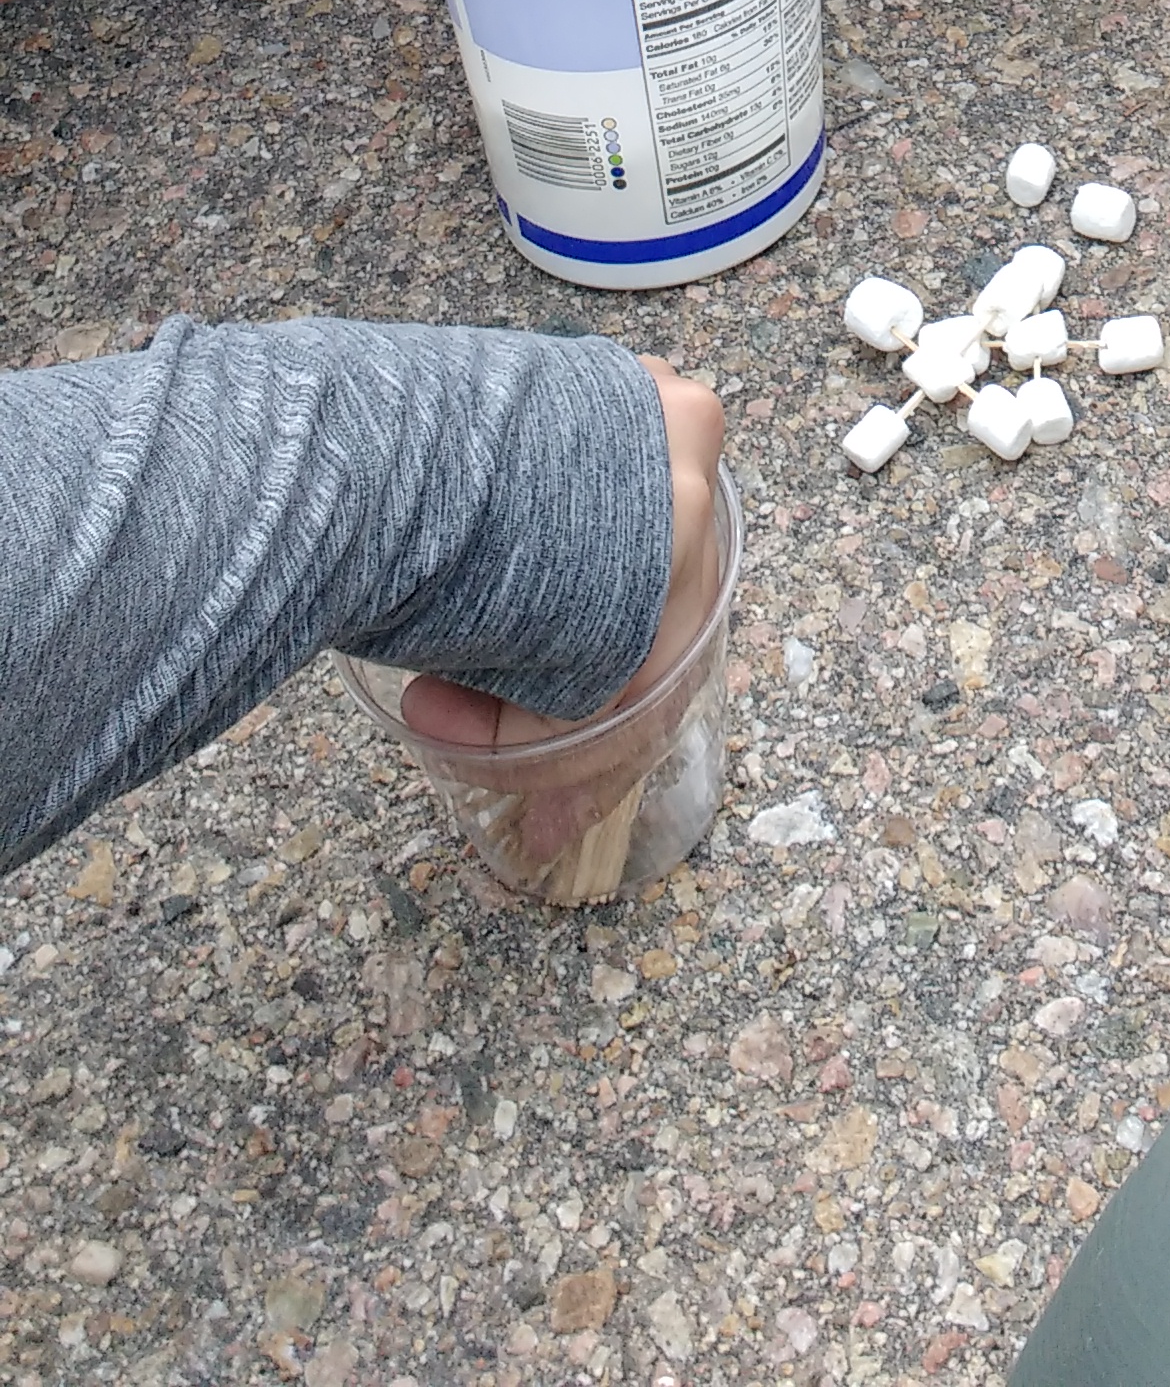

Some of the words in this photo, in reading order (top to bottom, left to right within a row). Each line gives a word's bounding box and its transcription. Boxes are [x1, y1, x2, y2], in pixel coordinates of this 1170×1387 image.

[641, 5, 682, 21] Servings
[644, 26, 677, 40] Amount
[696, 10, 726, 25] Serving
[646, 38, 690, 53] Calories
[650, 67, 678, 80] Total
[681, 61, 699, 72] Fat
[701, 55, 717, 67] 10g
[659, 73, 702, 92] Saturated
[704, 67, 718, 78] Fat
[662, 91, 687, 105] Trans
[688, 85, 703, 95] Fat
[656, 96, 717, 121] Cholesterol
[658, 118, 699, 133] Sodium
[660, 133, 686, 146] Total
[687, 109, 749, 139] Carbohydrate
[584, 124, 602, 153] 2251
[668, 144, 699, 159] Dietary
[701, 134, 722, 149] Fiber
[670, 158, 701, 172] Sugars
[666, 171, 703, 185] Protein
[668, 192, 701, 207] Vitamin
[670, 205, 705, 219] Calcium
